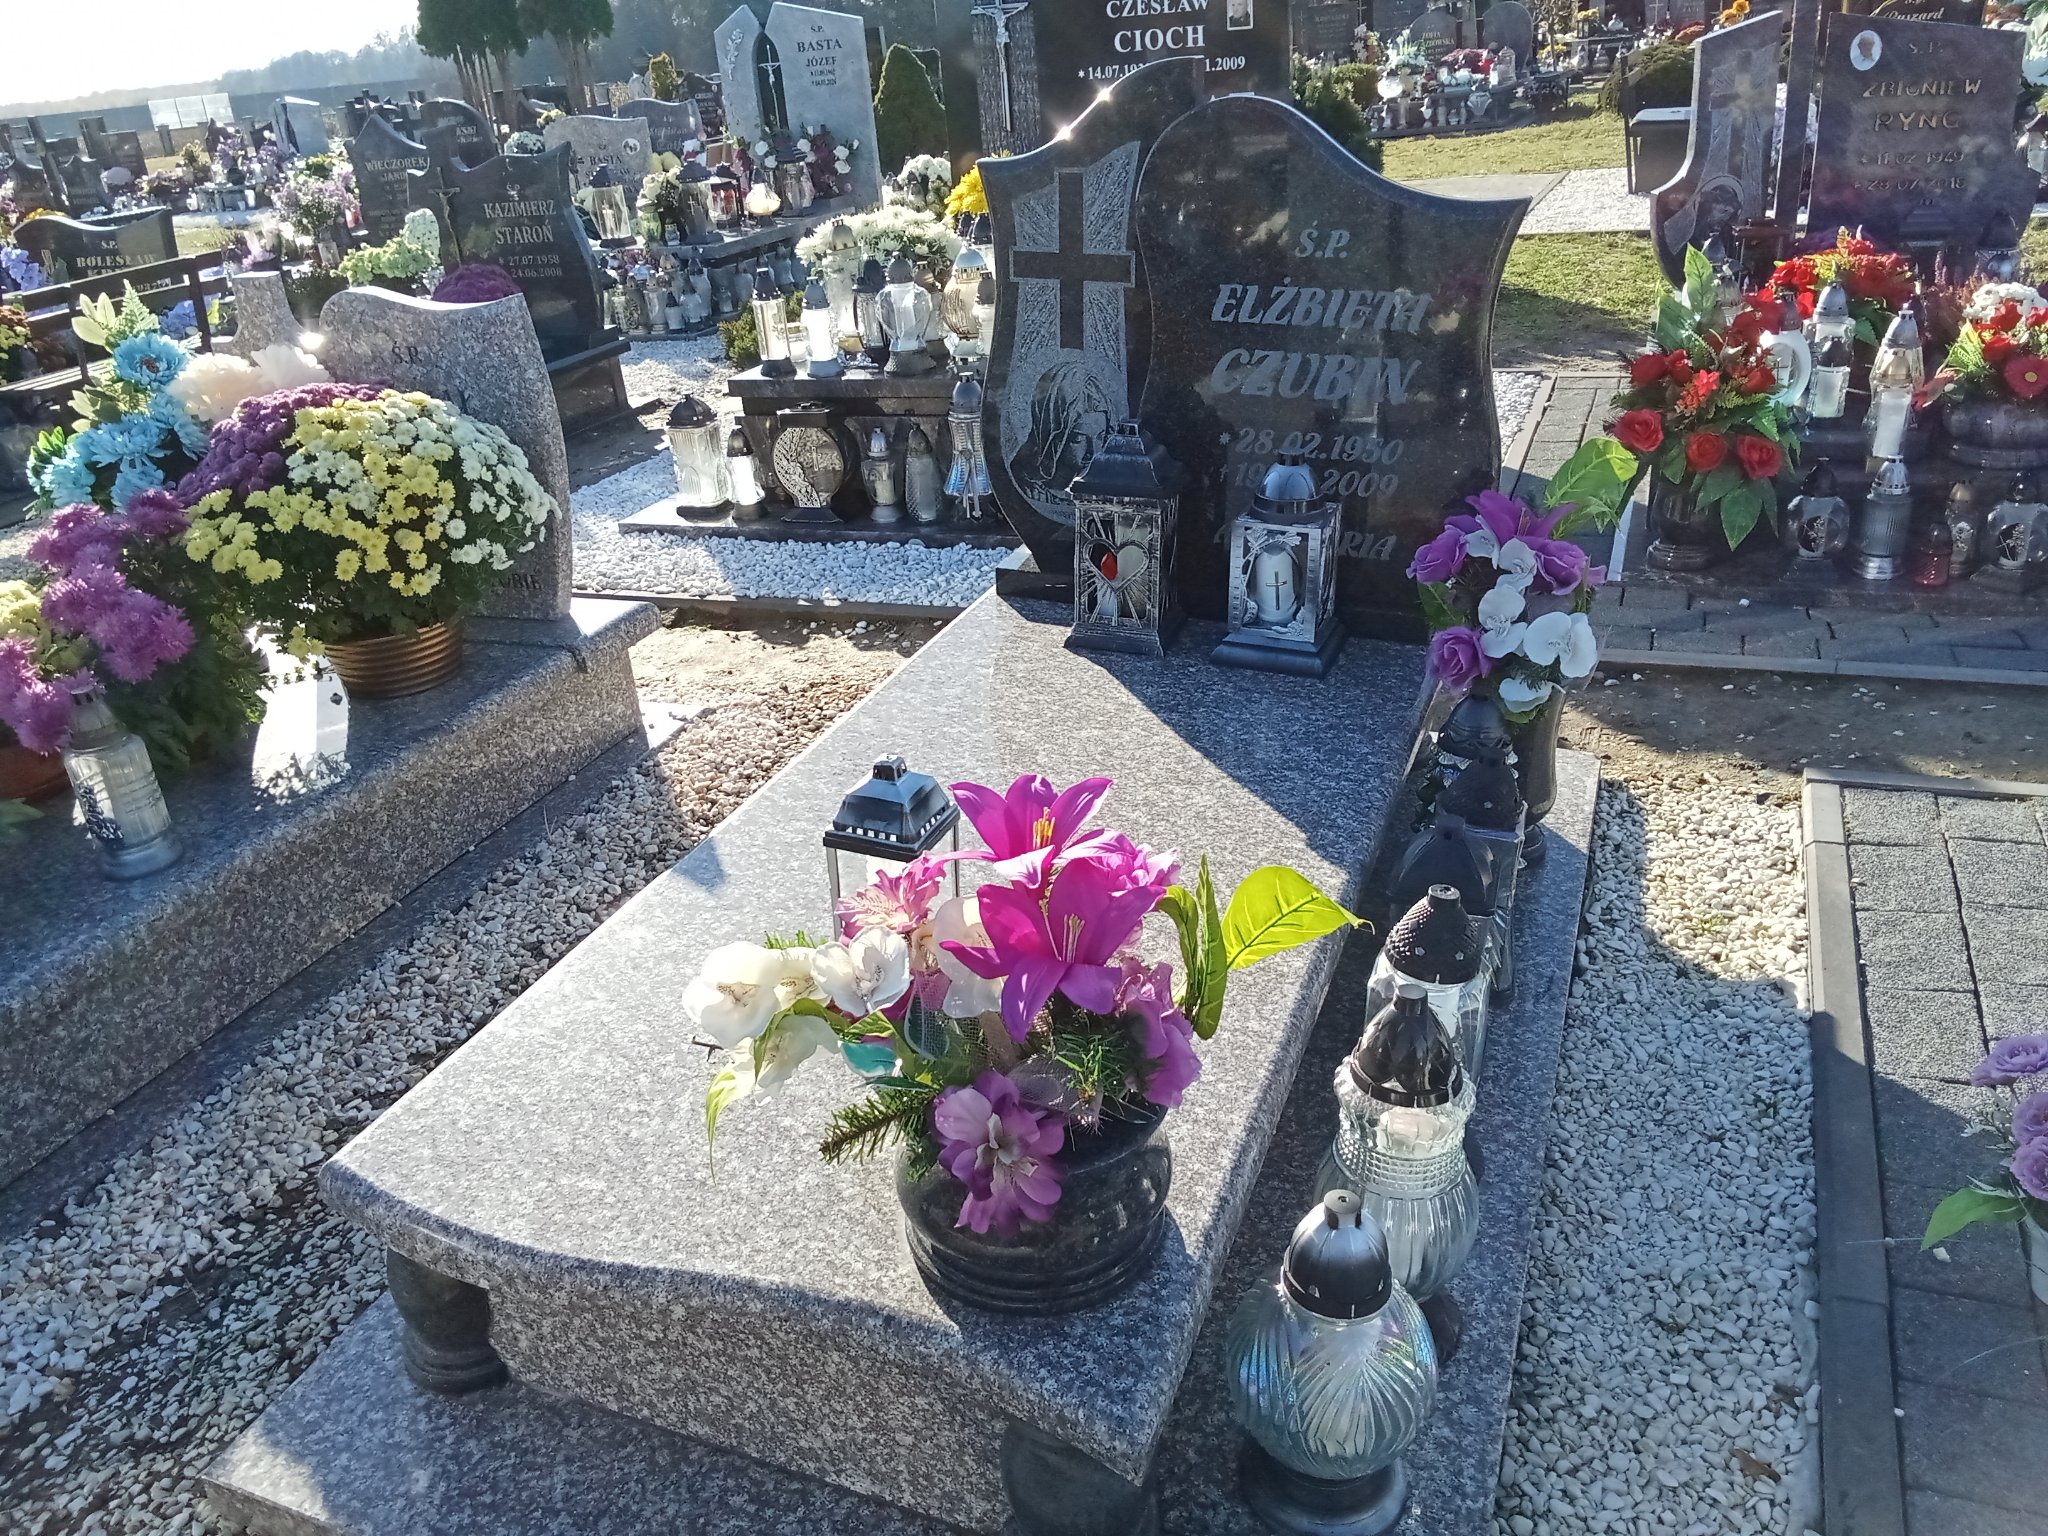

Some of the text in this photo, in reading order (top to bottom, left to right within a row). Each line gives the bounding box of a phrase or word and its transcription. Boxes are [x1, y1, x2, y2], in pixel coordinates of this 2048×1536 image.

[1106, 0, 1209, 18] CZESŁAW
[797, 39, 842, 53] BASTA
[1114, 25, 1206, 53] CIOCH
[806, 56, 837, 67] JÓZEF
[364, 157, 427, 172] WIECZOREK
[483, 200, 557, 219] KAZIMIERZ
[495, 219, 554, 245] STAROŃ
[1296, 220, 1350, 259] Ś.P.
[1211, 277, 1433, 334] ELŻBIETA
